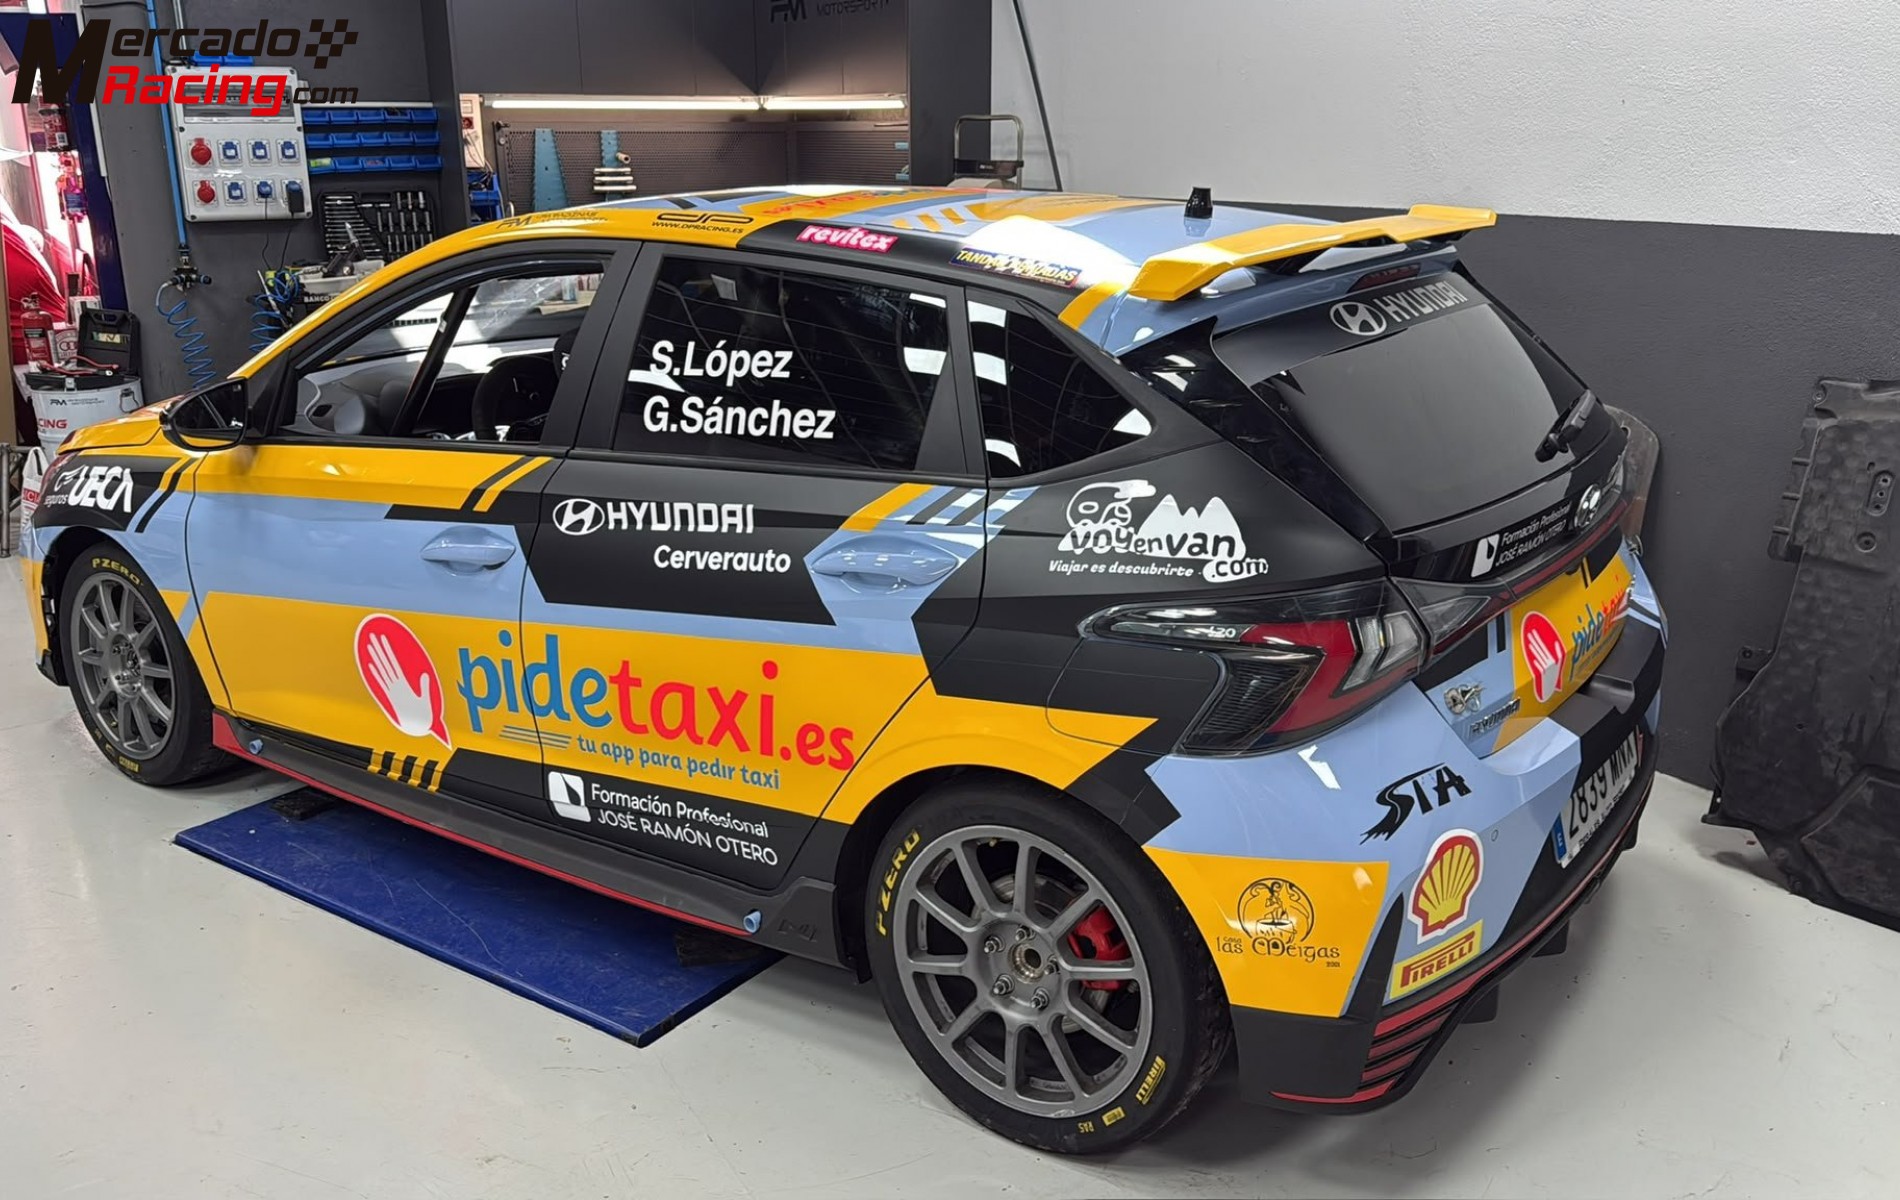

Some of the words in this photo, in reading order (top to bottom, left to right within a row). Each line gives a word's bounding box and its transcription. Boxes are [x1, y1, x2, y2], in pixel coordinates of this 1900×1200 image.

[801, 226, 893, 251] revitex
[1373, 281, 1468, 323] HYUNDAI
[650, 340, 793, 387] S.López
[643, 395, 836, 439] G.Sánchez
[606, 502, 754, 534] HYUNDAI
[653, 545, 791, 573] Cerverauto
[1049, 560, 1086, 576] Viajar
[1090, 563, 1104, 573] es
[1108, 562, 1194, 577] descubrirte
[456, 629, 854, 771] pidetaxi.es
[577, 735, 597, 754] tu
[601, 742, 635, 763] app
[639, 748, 682, 768] para
[687, 756, 736, 778] pedir
[740, 764, 780, 791] taxi
[591, 783, 671, 817] Formación
[676, 801, 769, 838] Profesional
[1569, 766, 1608, 839] 2839
[598, 809, 638, 831] JOSÉ
[640, 818, 712, 848] RAMÓN
[715, 835, 778, 866] OTERO
[1252, 936, 1340, 963] Meigas
[1400, 931, 1475, 989] PIRELLI
